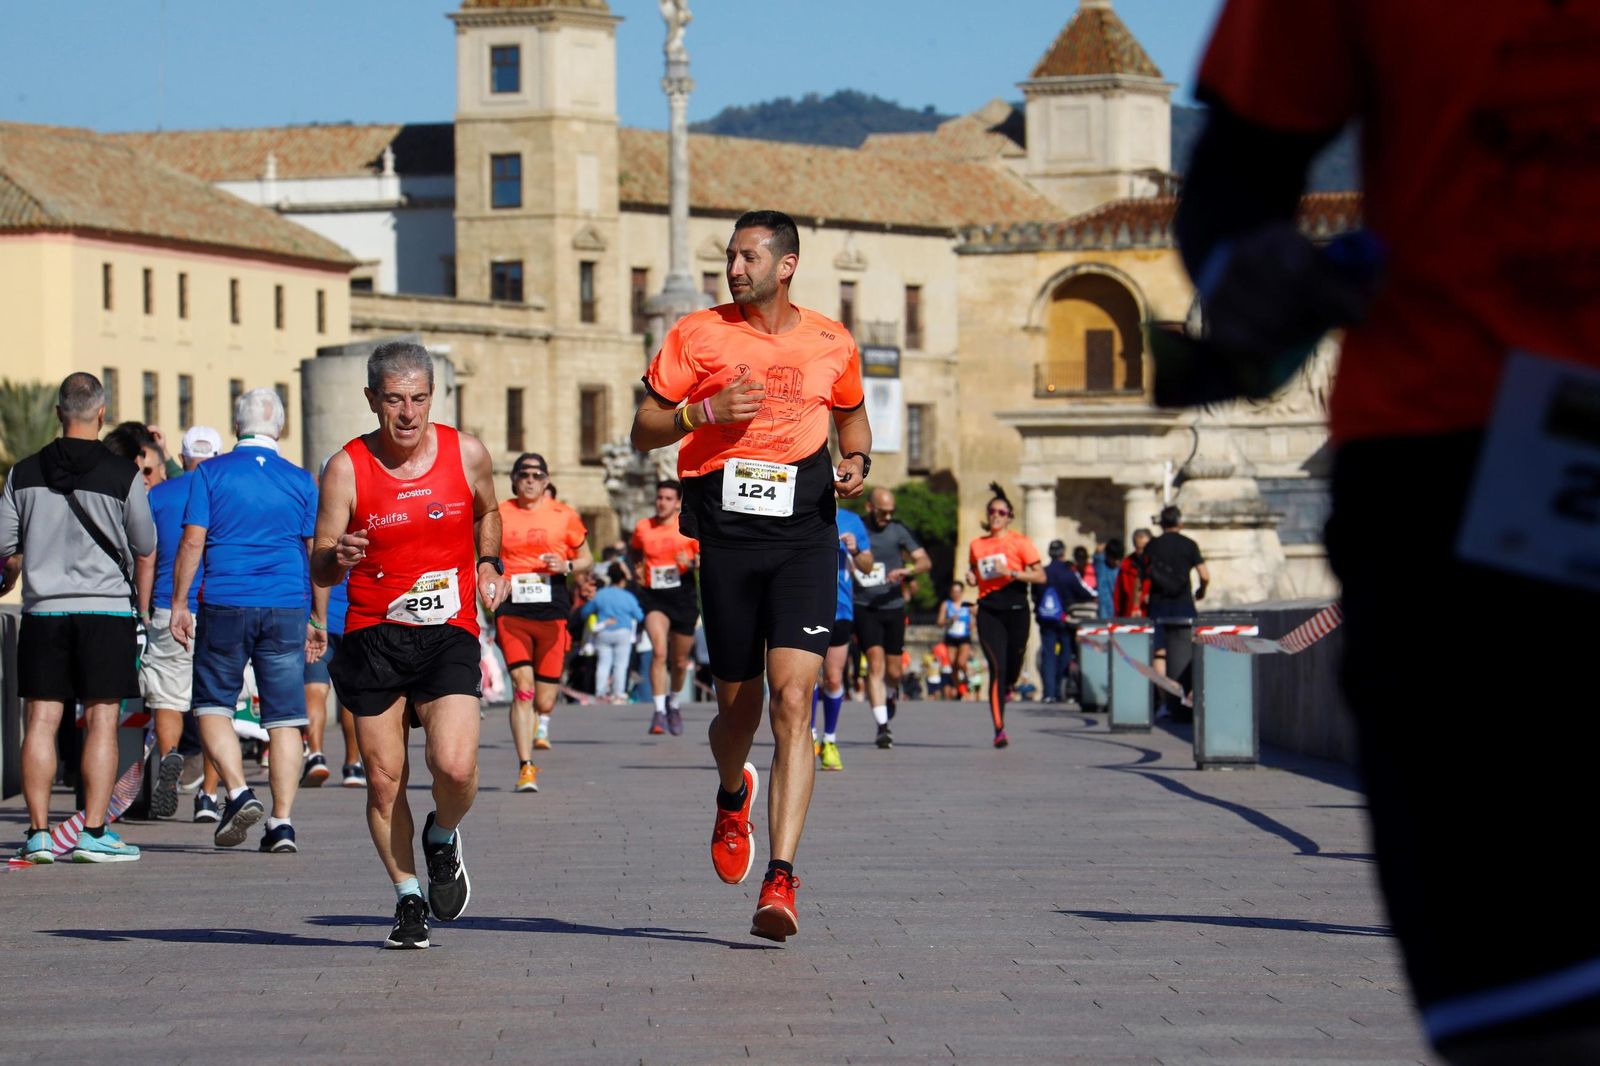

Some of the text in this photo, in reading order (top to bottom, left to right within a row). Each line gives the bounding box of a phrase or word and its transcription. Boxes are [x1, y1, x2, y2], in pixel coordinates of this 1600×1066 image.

[738, 482, 776, 501] 124
[375, 512, 408, 526] califas
[405, 595, 444, 612] 291
